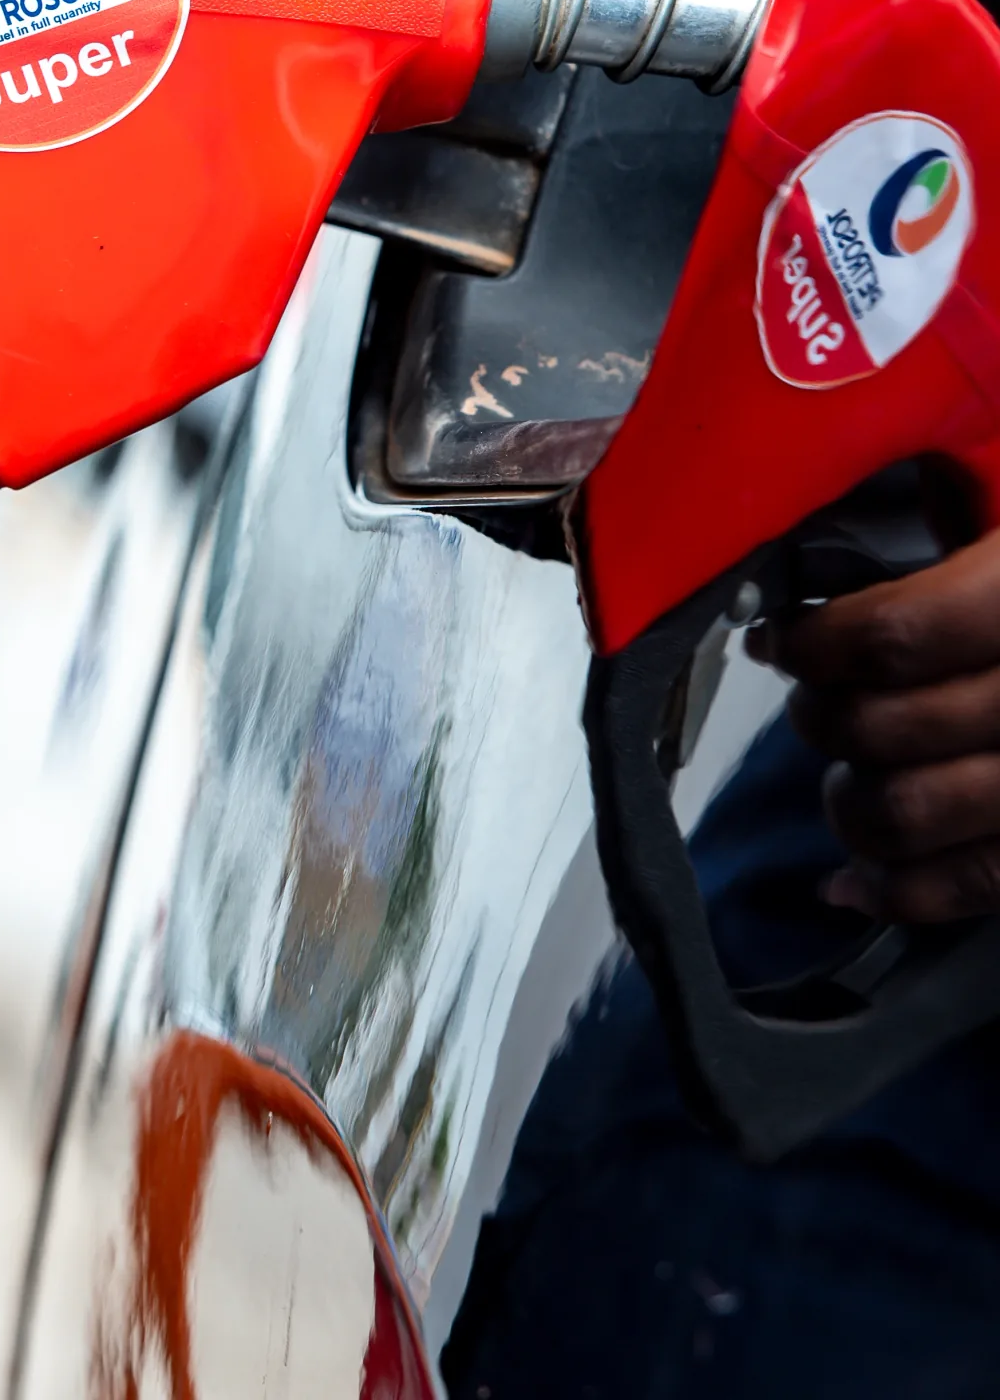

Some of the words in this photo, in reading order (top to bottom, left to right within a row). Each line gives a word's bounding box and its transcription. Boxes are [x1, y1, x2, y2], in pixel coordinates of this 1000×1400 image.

[17, 25, 29, 37] in
[31, 16, 51, 32] full
[53, 0, 101, 24] quantity
